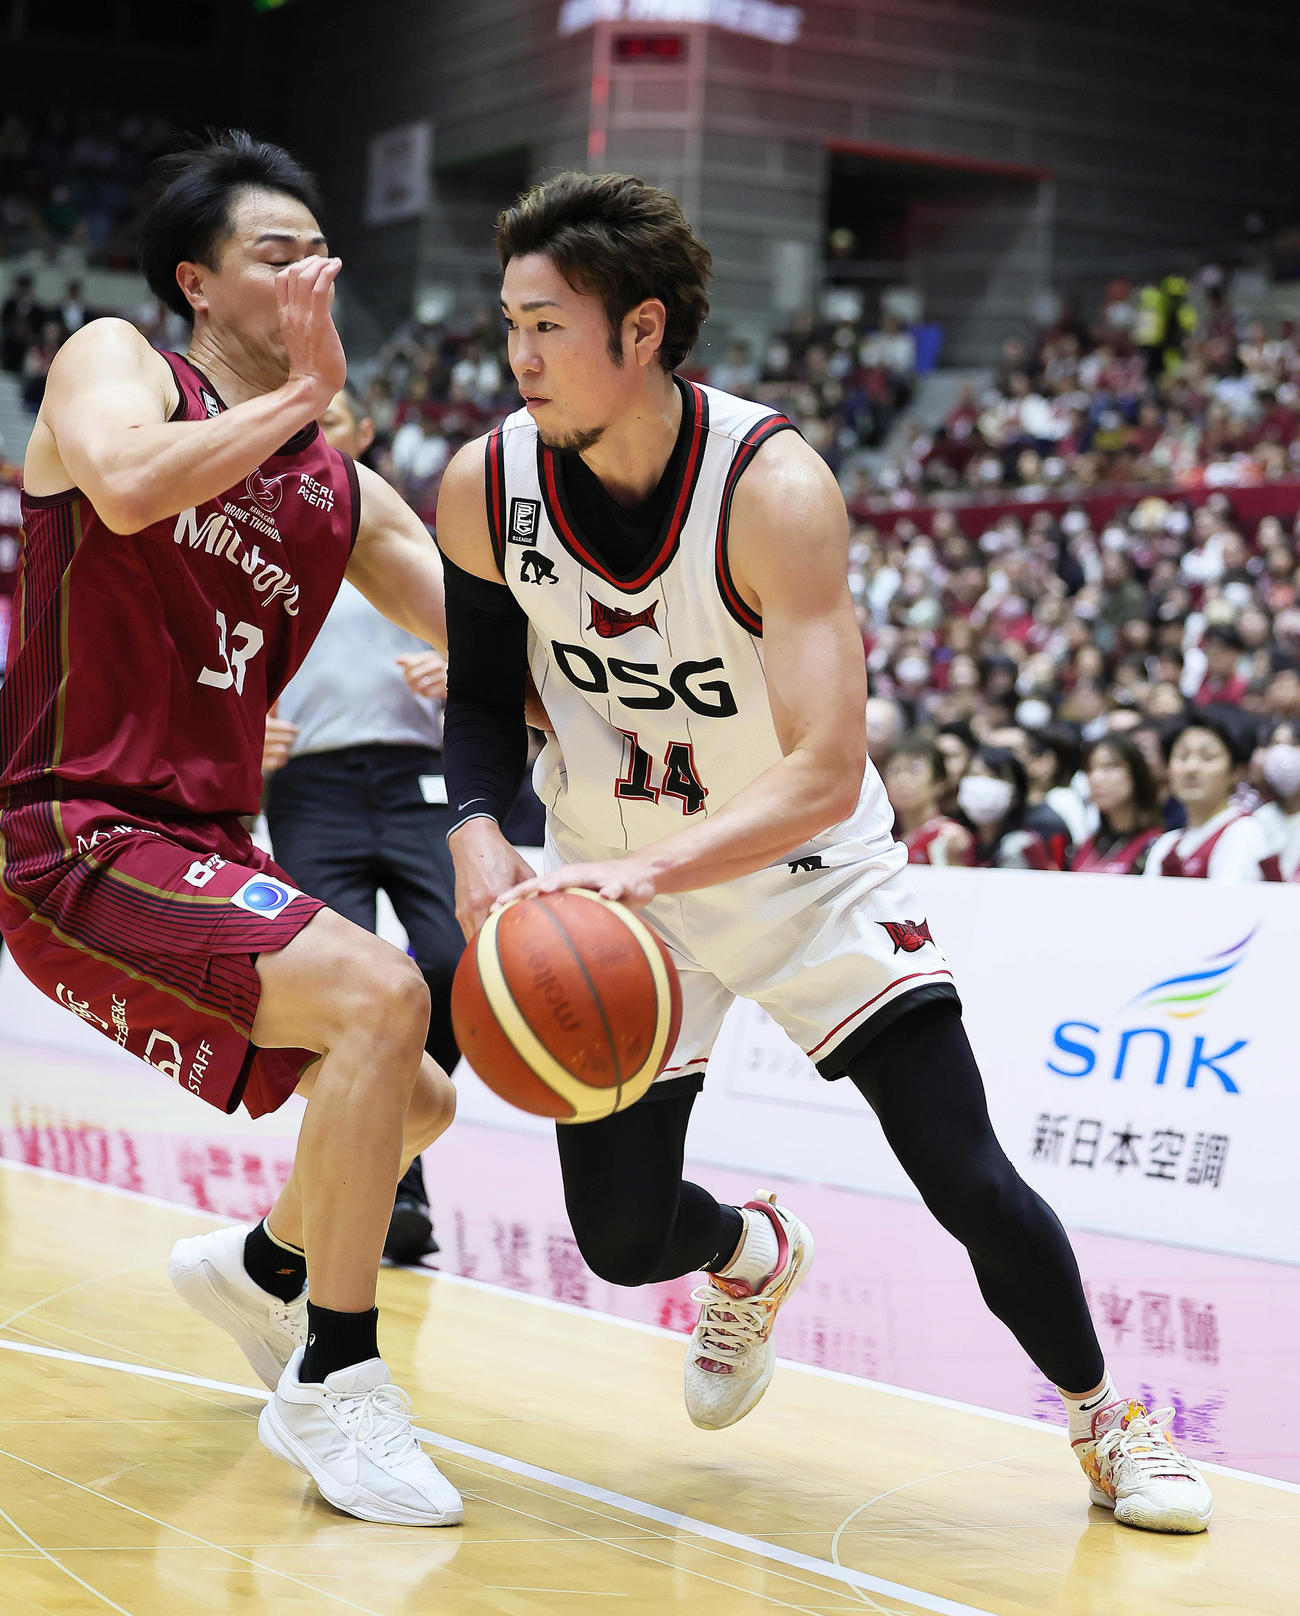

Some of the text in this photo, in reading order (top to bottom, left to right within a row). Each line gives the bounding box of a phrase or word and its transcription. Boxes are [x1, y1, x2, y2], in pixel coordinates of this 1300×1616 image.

[223, 501, 250, 524] BRAVE
[296, 484, 334, 512] AGENT
[551, 640, 738, 717] OSG
[614, 727, 710, 816] 14
[187, 1040, 215, 1095] STAFF
[1030, 1112, 1230, 1190] 新日本空調
